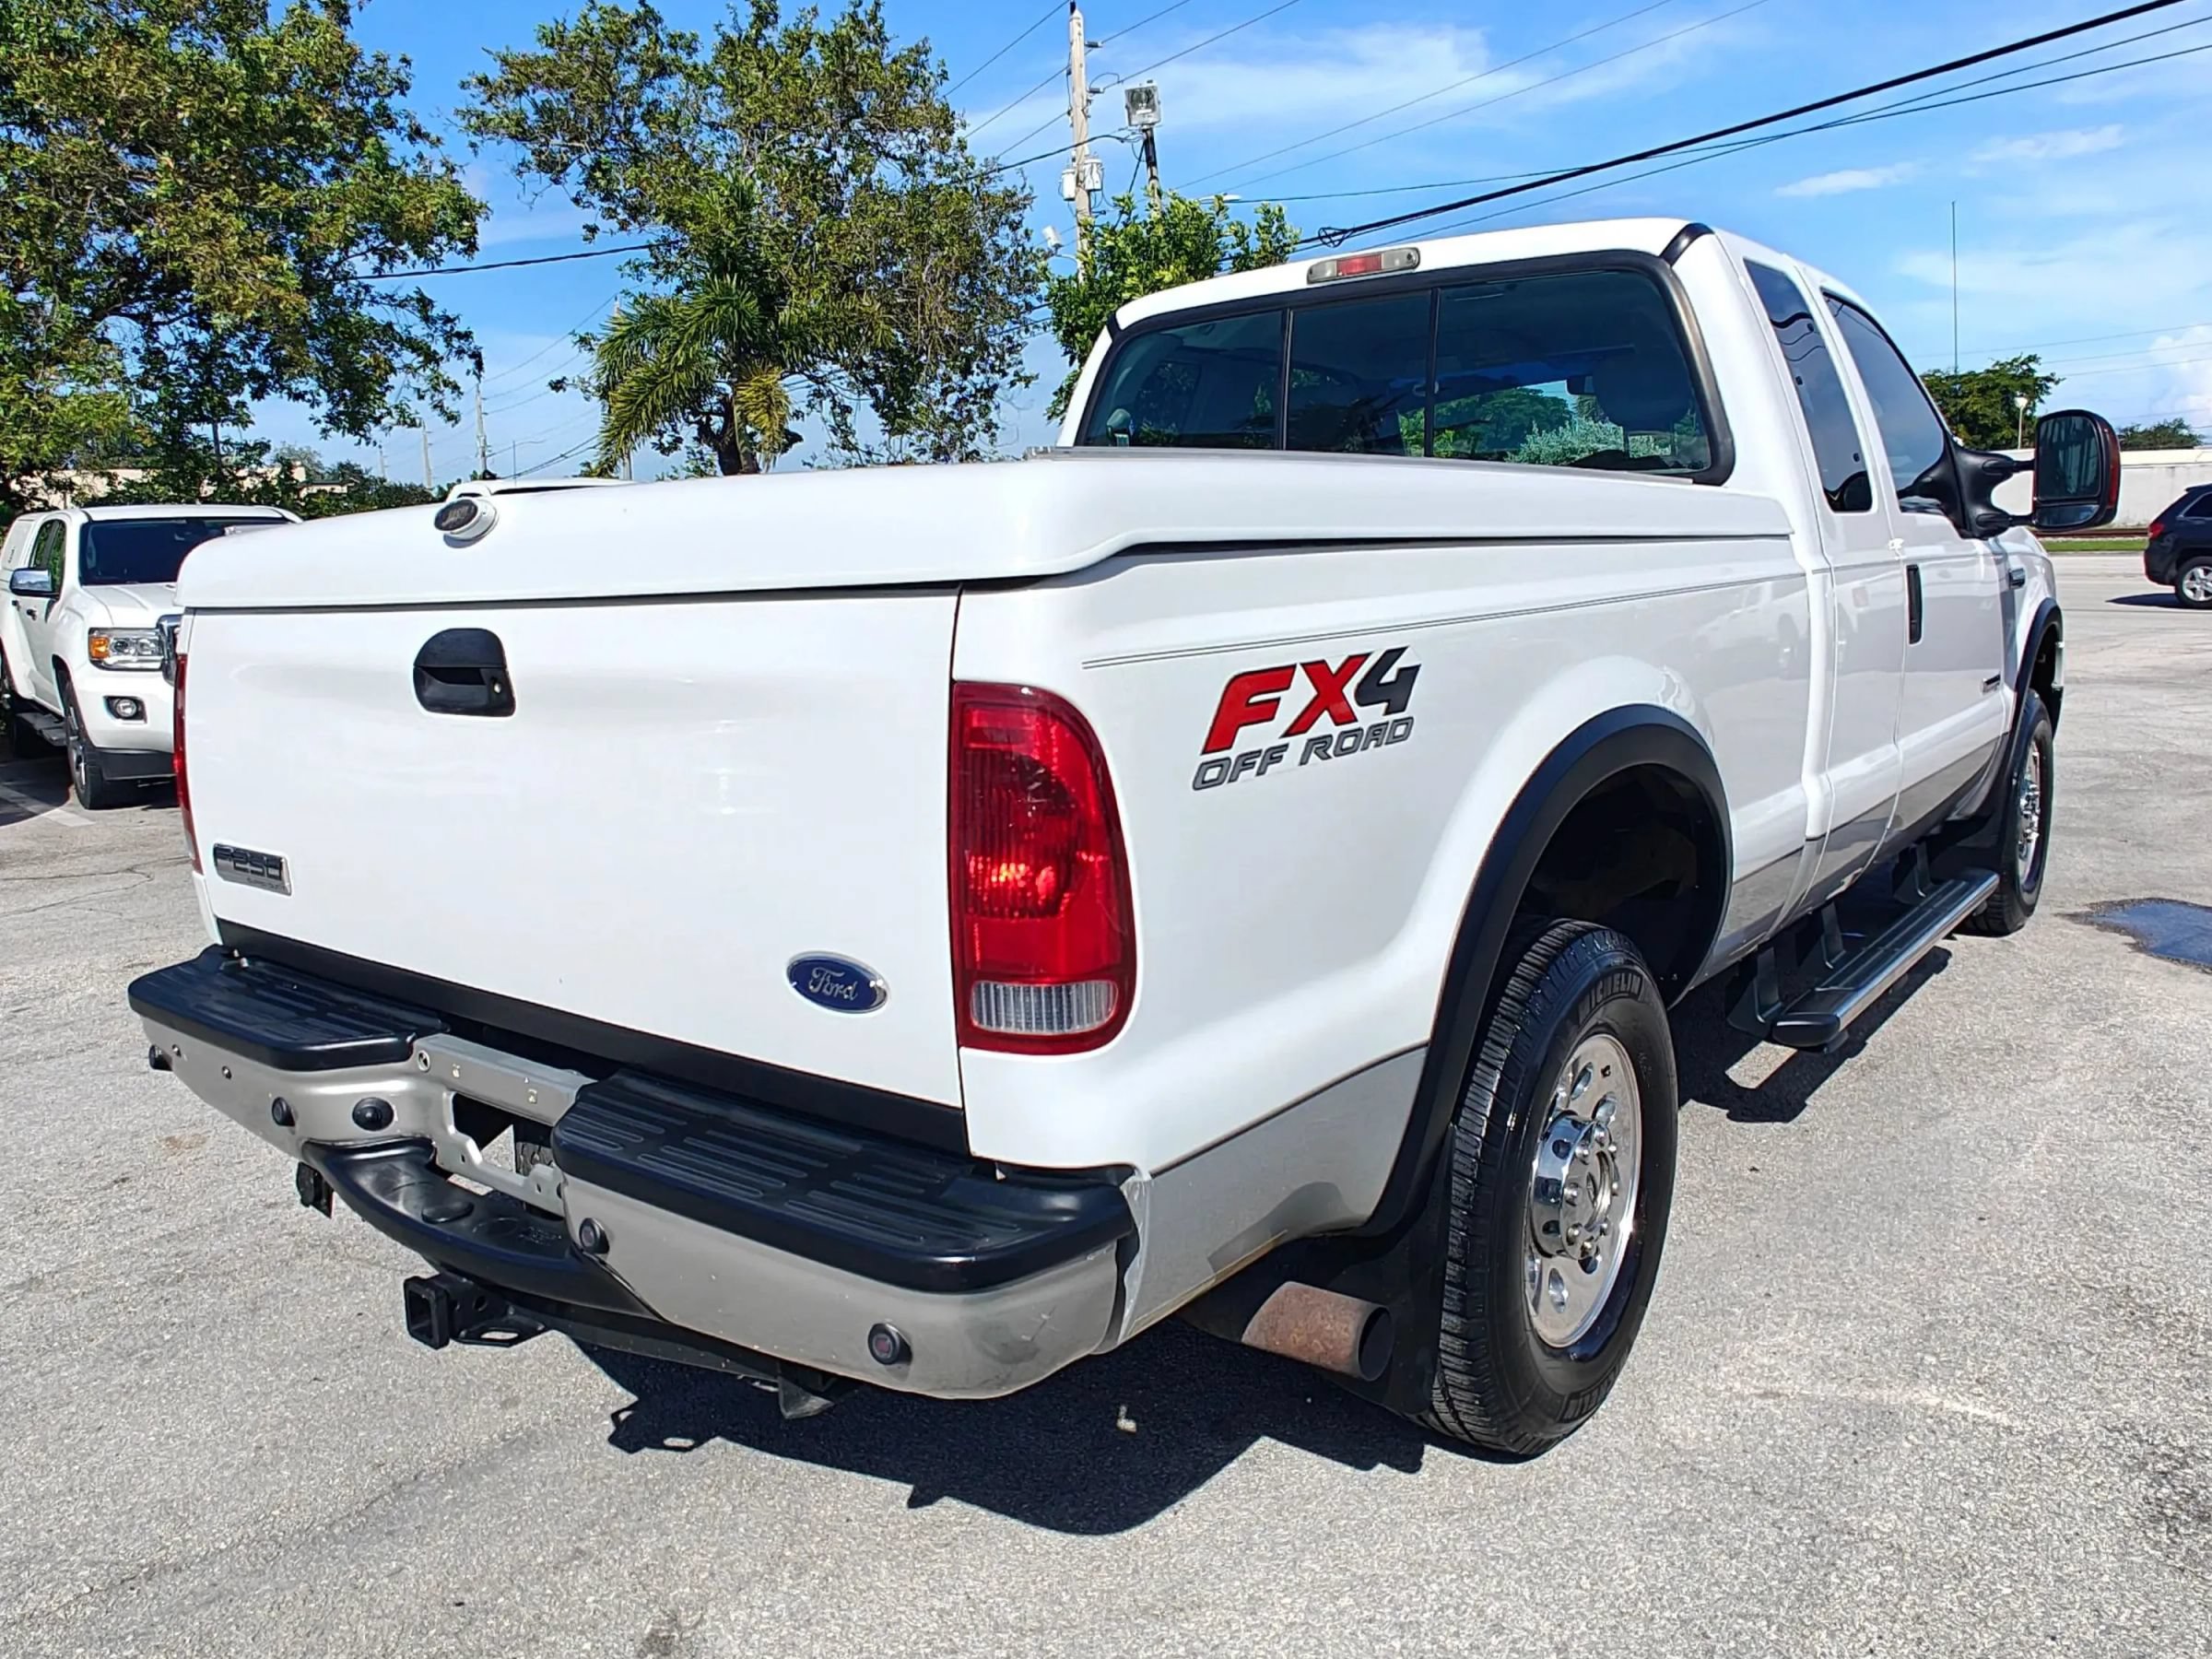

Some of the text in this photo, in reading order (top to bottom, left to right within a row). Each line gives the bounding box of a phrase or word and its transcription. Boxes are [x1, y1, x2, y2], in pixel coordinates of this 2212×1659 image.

[1200, 646, 1421, 756] FX4
[1192, 716, 1414, 791] OFF ROAD
[808, 966, 859, 1001] Ford
[1578, 972, 1641, 1024] MICHELIN
